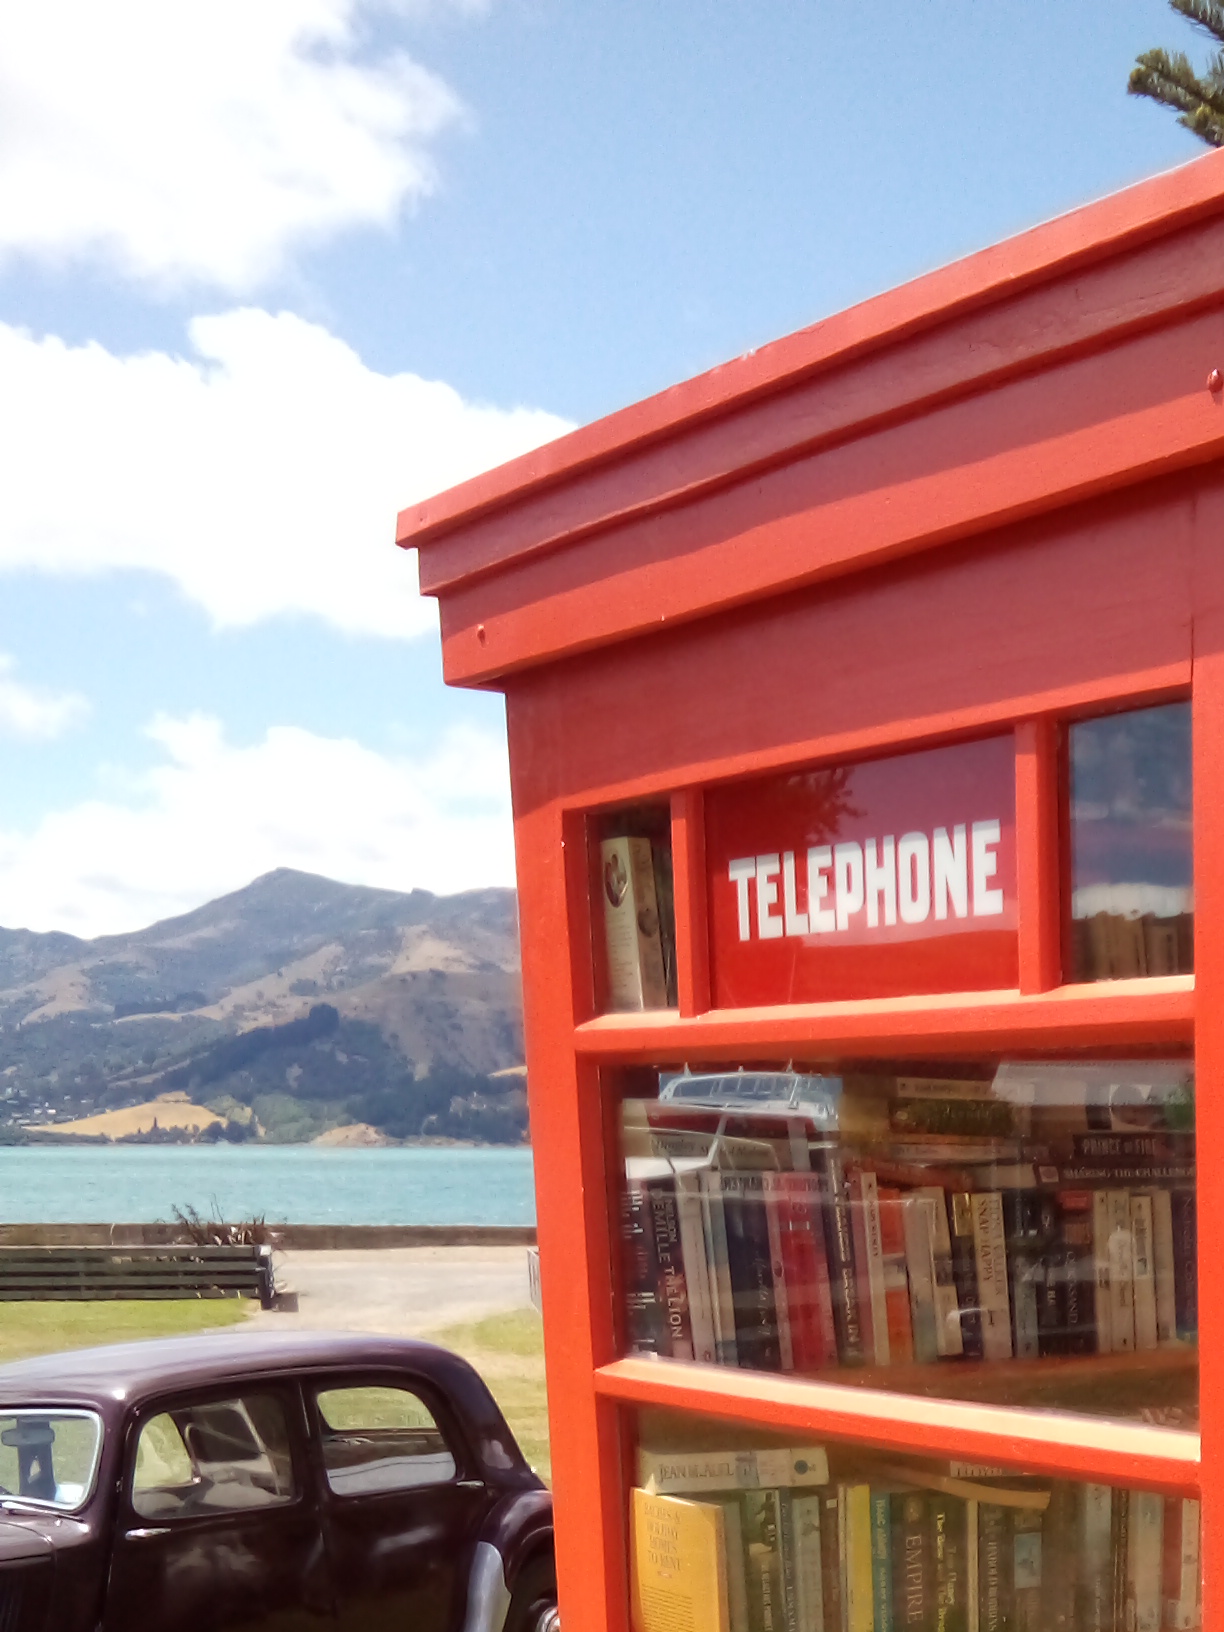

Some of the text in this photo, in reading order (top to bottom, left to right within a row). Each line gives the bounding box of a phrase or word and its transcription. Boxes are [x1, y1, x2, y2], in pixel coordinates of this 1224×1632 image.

[728, 818, 1004, 942] TELEPHONE
[651, 1188, 671, 1264] EMILLE
[667, 1297, 684, 1339] LION
[658, 1462, 687, 1484] JEAN
[904, 1533, 924, 1625] EMPIRE
